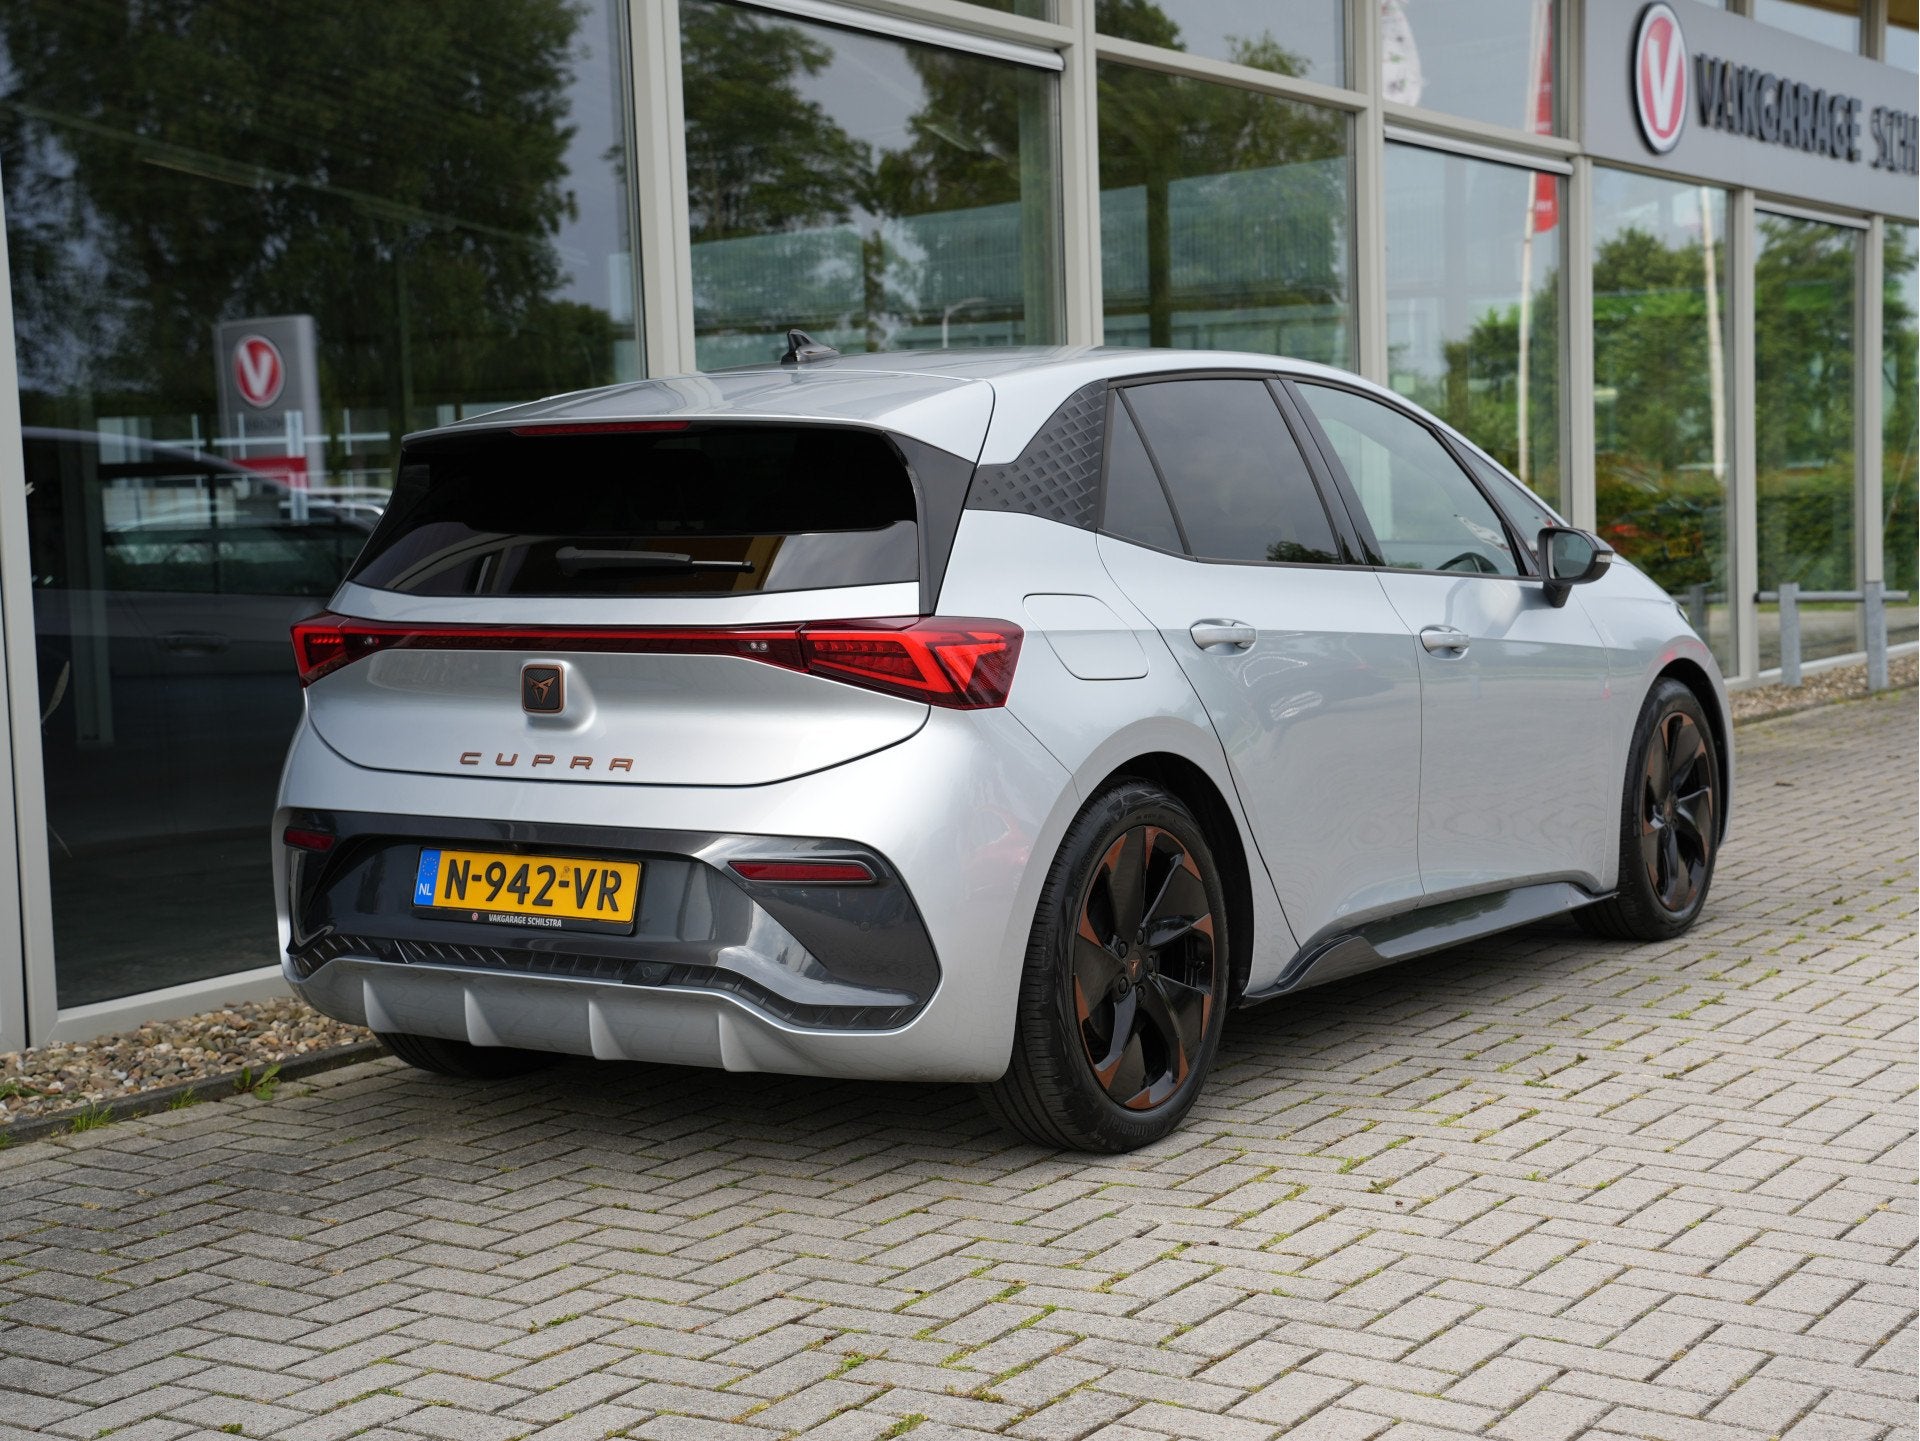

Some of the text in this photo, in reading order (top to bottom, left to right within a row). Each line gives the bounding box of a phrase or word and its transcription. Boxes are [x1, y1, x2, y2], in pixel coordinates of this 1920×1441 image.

[1694, 53, 1920, 175] VAKGARAGE SCH
[459, 752, 634, 771] CUPRA
[418, 883, 432, 896] NL
[444, 859, 622, 912] N-942-VR
[488, 913, 562, 928] VAKGARAGE SCHILSTRA
